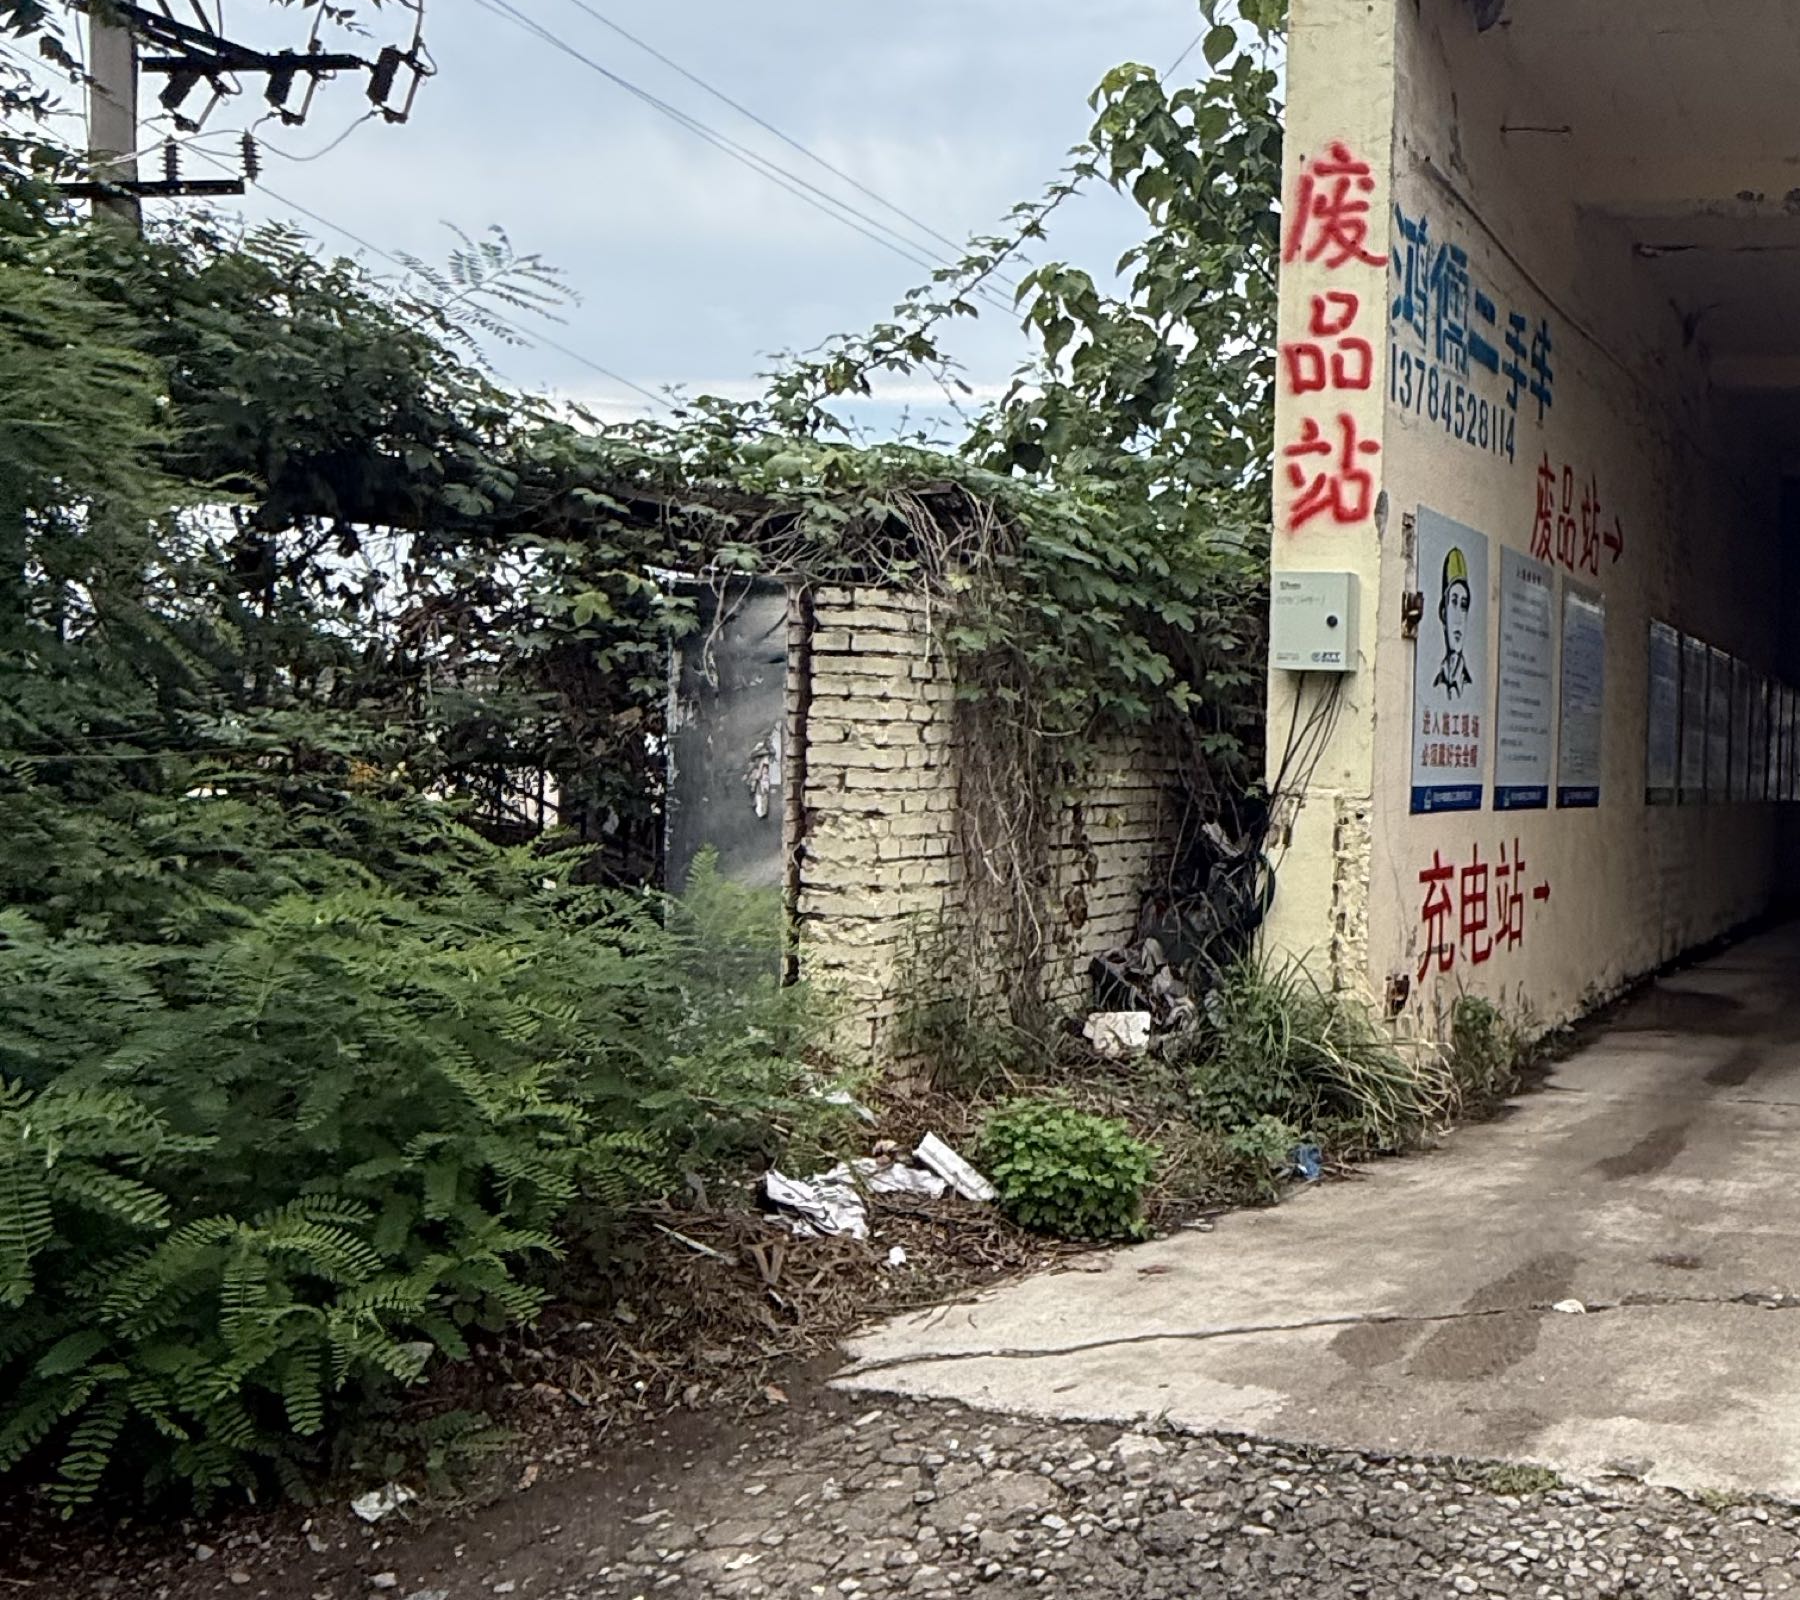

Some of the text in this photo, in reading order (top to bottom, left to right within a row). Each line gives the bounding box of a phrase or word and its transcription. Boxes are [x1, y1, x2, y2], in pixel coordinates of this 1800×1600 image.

[1283, 140, 1389, 531] 废品站
[1391, 201, 1553, 421] 鸿儒二手车
[1390, 343, 1516, 465] 13784528114
[1529, 449, 1601, 577] 废品站
[1416, 837, 1526, 985] 充电站
